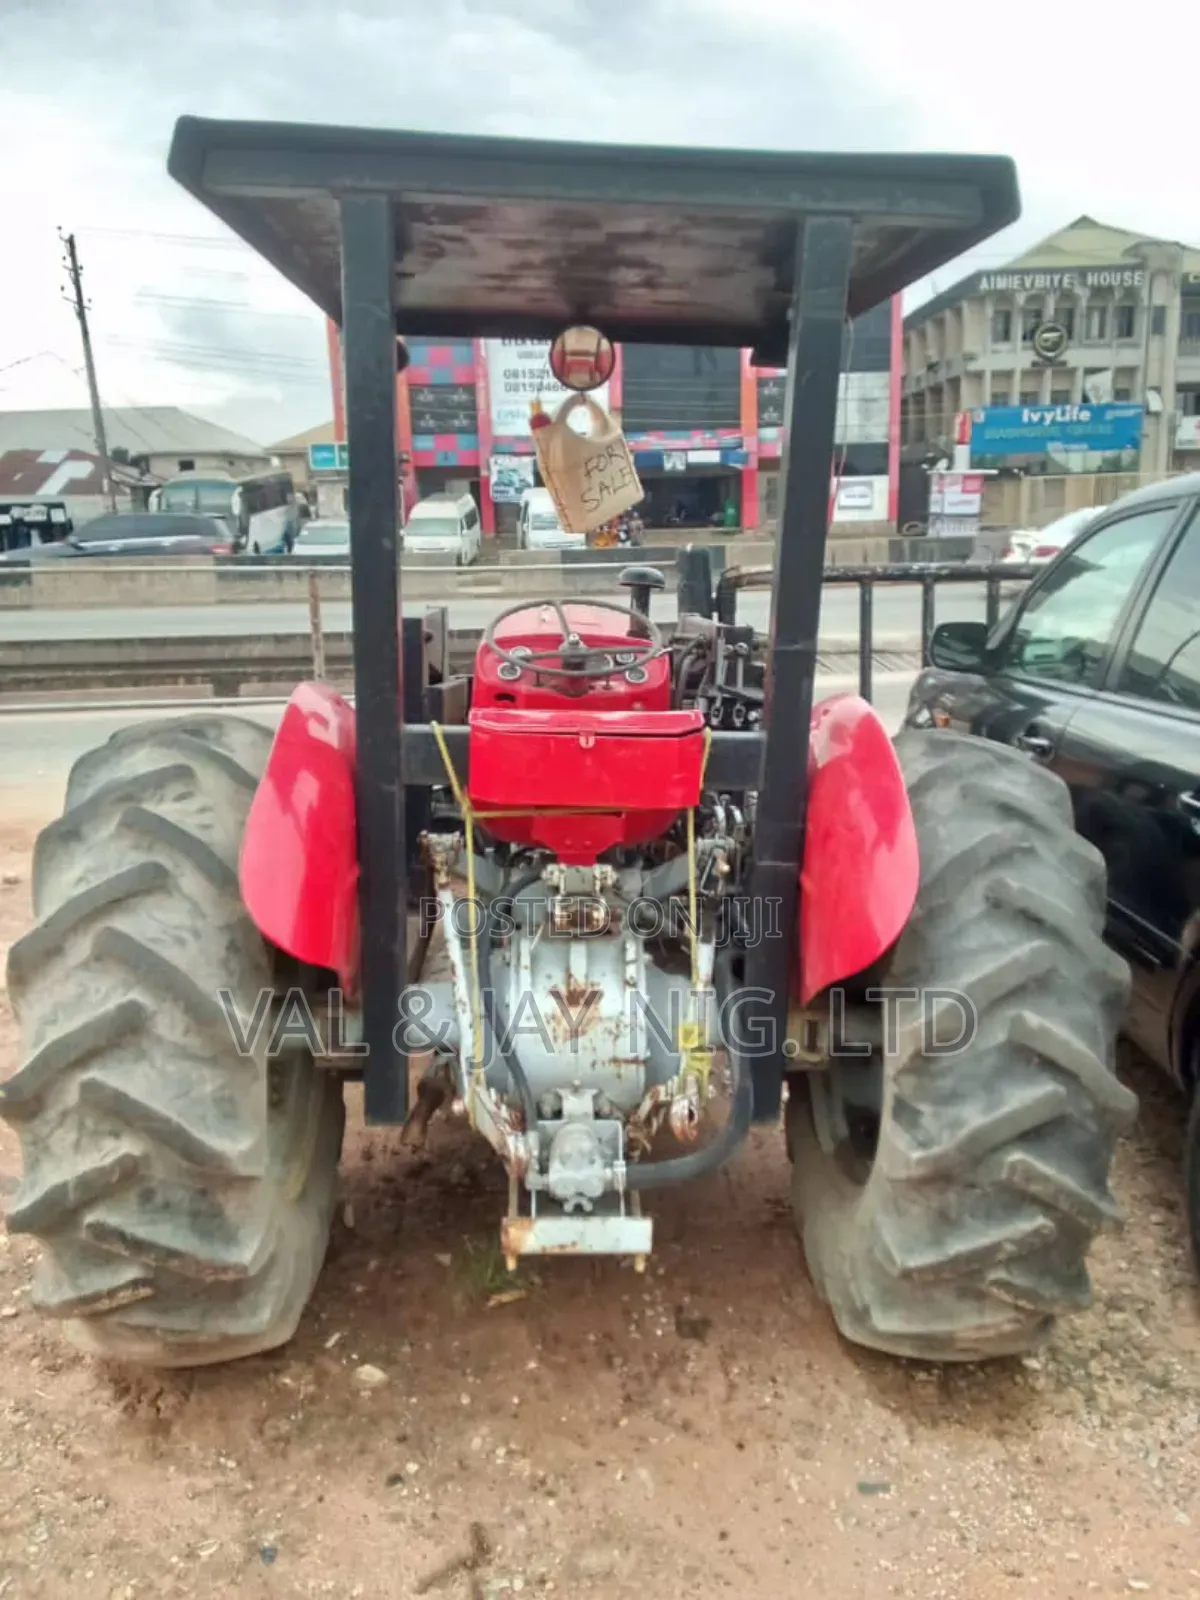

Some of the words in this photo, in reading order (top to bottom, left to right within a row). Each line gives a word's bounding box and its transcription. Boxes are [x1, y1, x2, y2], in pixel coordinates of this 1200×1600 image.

[1086, 270, 1145, 287] HOUSE
[1021, 404, 1092, 426] IvyLife
[583, 443, 625, 478] FOR
[580, 466, 633, 512] SALE
